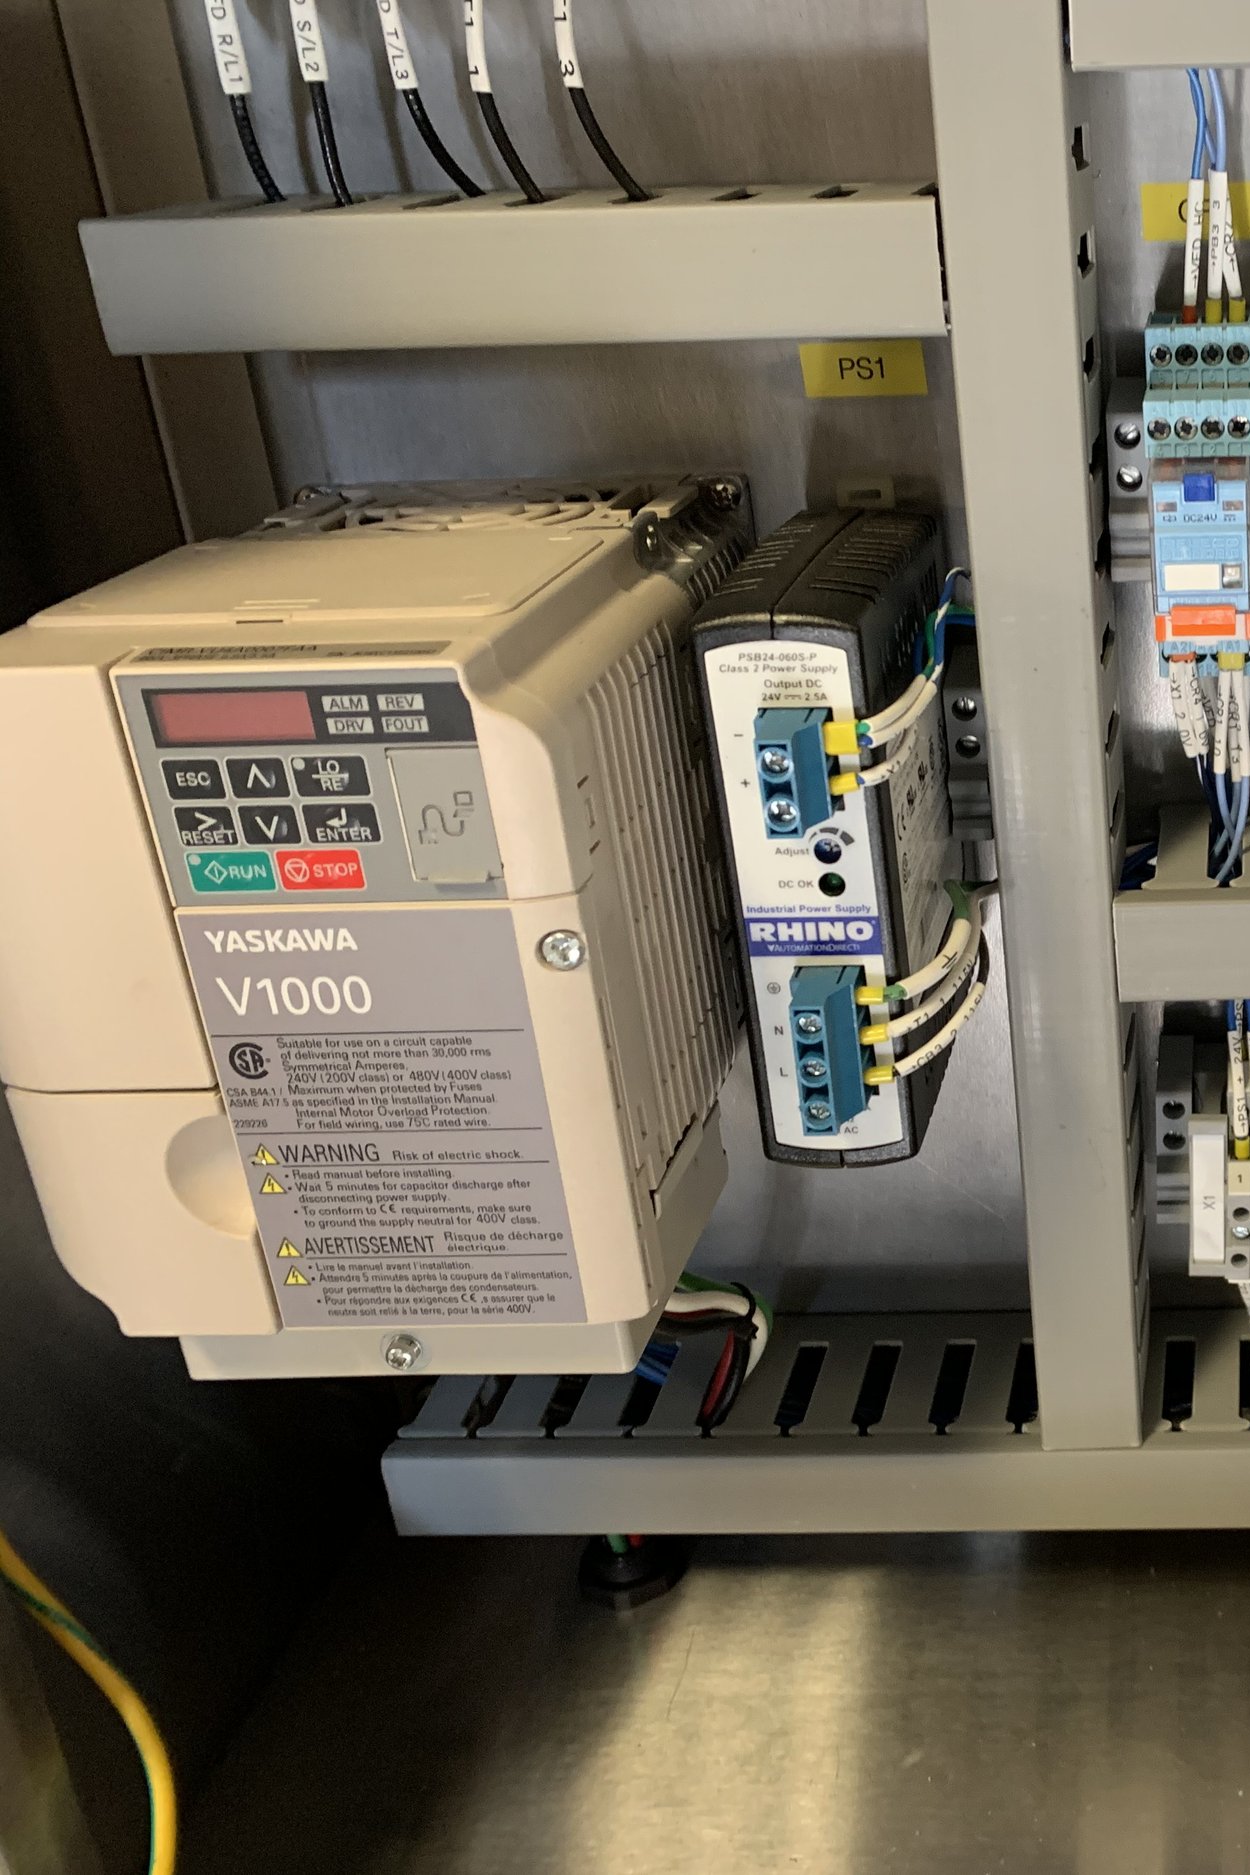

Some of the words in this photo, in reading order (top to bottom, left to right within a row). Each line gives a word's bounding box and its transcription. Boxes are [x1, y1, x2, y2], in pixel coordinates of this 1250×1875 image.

[296, 21, 320, 73] S/L2
[217, 35, 244, 84] R/L1
[385, 30, 410, 81] T/L3
[838, 357, 885, 380] PS1
[719, 664, 749, 673] Class
[753, 664, 759, 672] 2
[763, 664, 796, 673] Power
[800, 664, 838, 674] Supply
[764, 679, 802, 689] Output
[805, 679, 822, 688] DC
[329, 697, 363, 711] ALM
[385, 696, 415, 710] REV
[762, 693, 781, 701] 24V
[334, 718, 365, 732] DRV
[385, 718, 425, 732] FOUT
[318, 760, 339, 775] LO
[175, 772, 211, 787] ESC
[321, 778, 344, 791] RE
[182, 831, 234, 845] RESET
[316, 828, 372, 842] ENTER
[775, 847, 809, 857] Adjust
[229, 864, 267, 879] RUN
[314, 863, 358, 878] STOP
[778, 880, 793, 888] DC
[798, 880, 814, 888] OK
[747, 905, 796, 913] Industrial
[835, 904, 871, 913] Supply
[749, 920, 874, 942] RHINO
[204, 928, 359, 954] YASKAWA
[217, 975, 374, 1017] V1000
[774, 1026, 783, 1035] N
[277, 1037, 322, 1049] Suitable
[325, 1038, 340, 1048] for
[344, 1039, 363, 1048] use
[367, 1039, 381, 1047] on
[393, 1037, 427, 1047] circuit
[429, 1036, 473, 1049] capable
[280, 1051, 291, 1061] of
[295, 1050, 349, 1061] delivering
[352, 1049, 371, 1059] not
[375, 1050, 403, 1058] more
[404, 1049, 429, 1058] than
[432, 1047, 467, 1059] 30,000
[470, 1049, 491, 1057] rms
[1233, 1036, 1243, 1064] 24V
[282, 1060, 352, 1074] Symmetrical
[780, 1068, 788, 1077] L
[295, 1107, 337, 1118] Internal
[339, 1106, 374, 1118] Motor
[377, 1106, 428, 1117] Overload
[297, 1119, 316, 1130] For
[319, 1118, 343, 1129] field
[345, 1118, 383, 1131] wiring,
[385, 1119, 404, 1128] use
[433, 1117, 461, 1127] rated
[463, 1118, 491, 1127] wire.
[278, 1143, 380, 1163] WARNING
[392, 1150, 419, 1161] Risk
[422, 1150, 436, 1160] of
[437, 1150, 483, 1160] electric
[485, 1149, 524, 1160] shock.
[292, 1169, 320, 1180] Read
[324, 1170, 363, 1179] manual
[366, 1169, 400, 1179] before
[402, 1168, 454, 1180] installing.
[1238, 1174, 1243, 1183] 1
[295, 1182, 322, 1192] Wait
[326, 1181, 334, 1192] 5
[337, 1181, 380, 1191] minutes
[382, 1180, 397, 1191] for
[400, 1180, 449, 1192] capacitor
[452, 1180, 504, 1191] discharge
[506, 1178, 531, 1188] after
[1203, 1195, 1216, 1210] X1
[305, 1235, 434, 1255] AVERTISSEMENT
